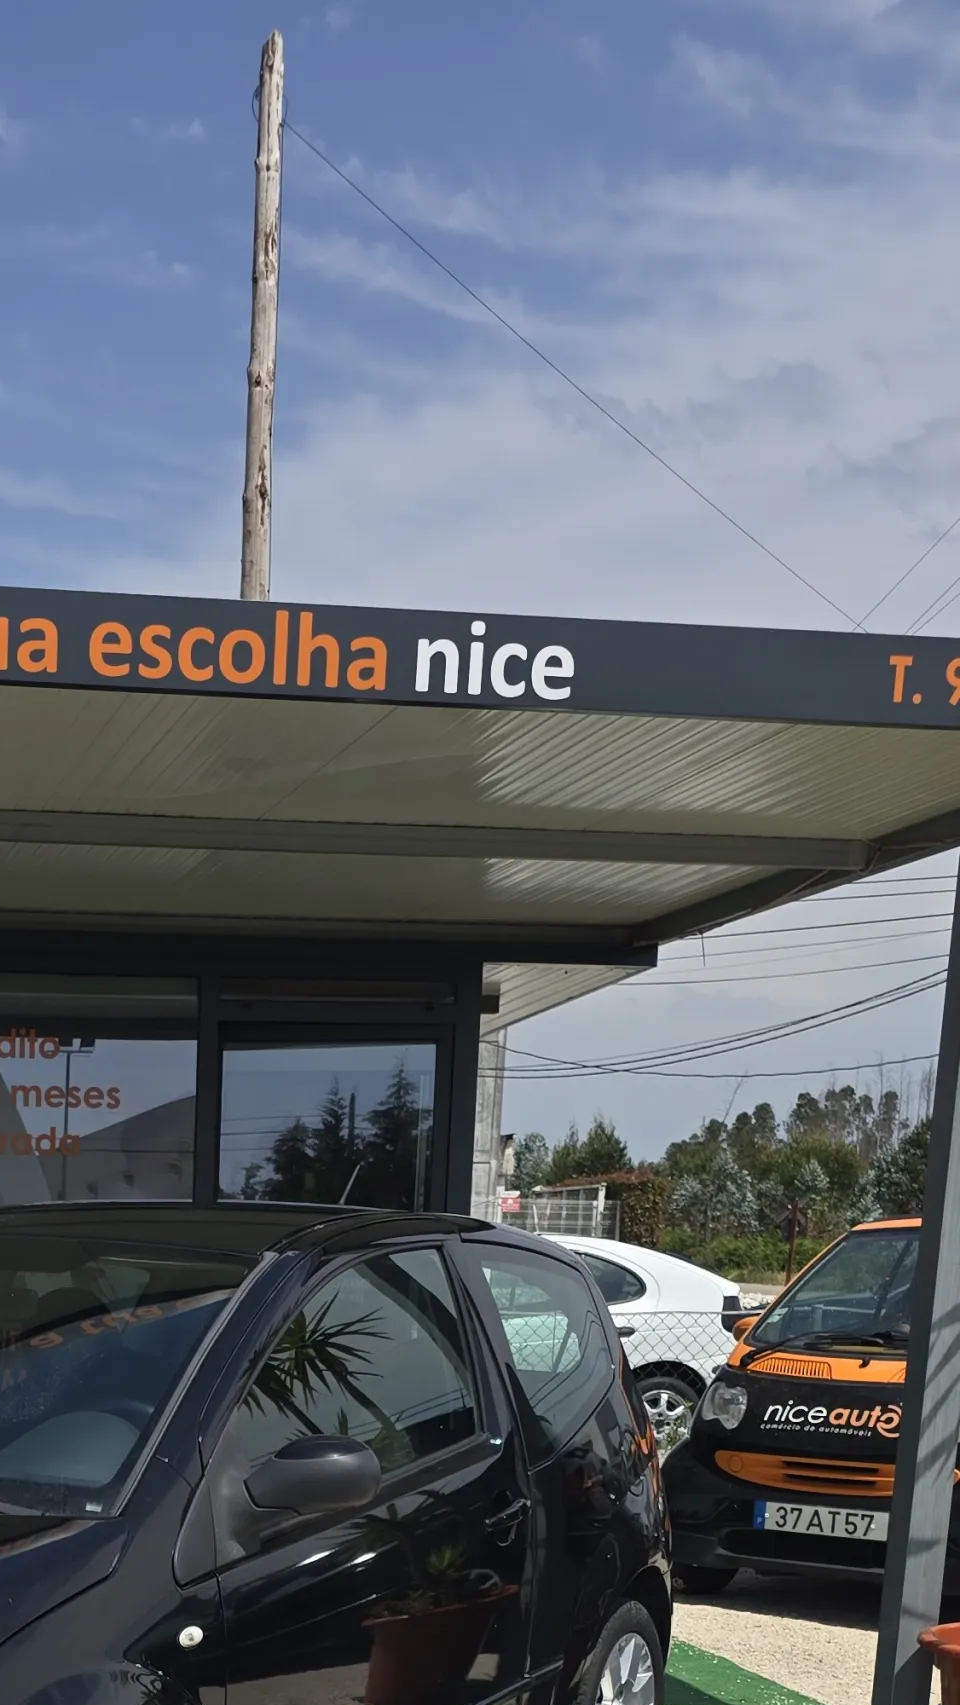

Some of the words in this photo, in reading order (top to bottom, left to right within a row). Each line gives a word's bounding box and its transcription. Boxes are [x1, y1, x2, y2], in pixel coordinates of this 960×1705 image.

[88, 609, 388, 692] escolha
[414, 620, 576, 701] nice
[888, 654, 923, 705] T.
[10, 1083, 122, 1110] meses
